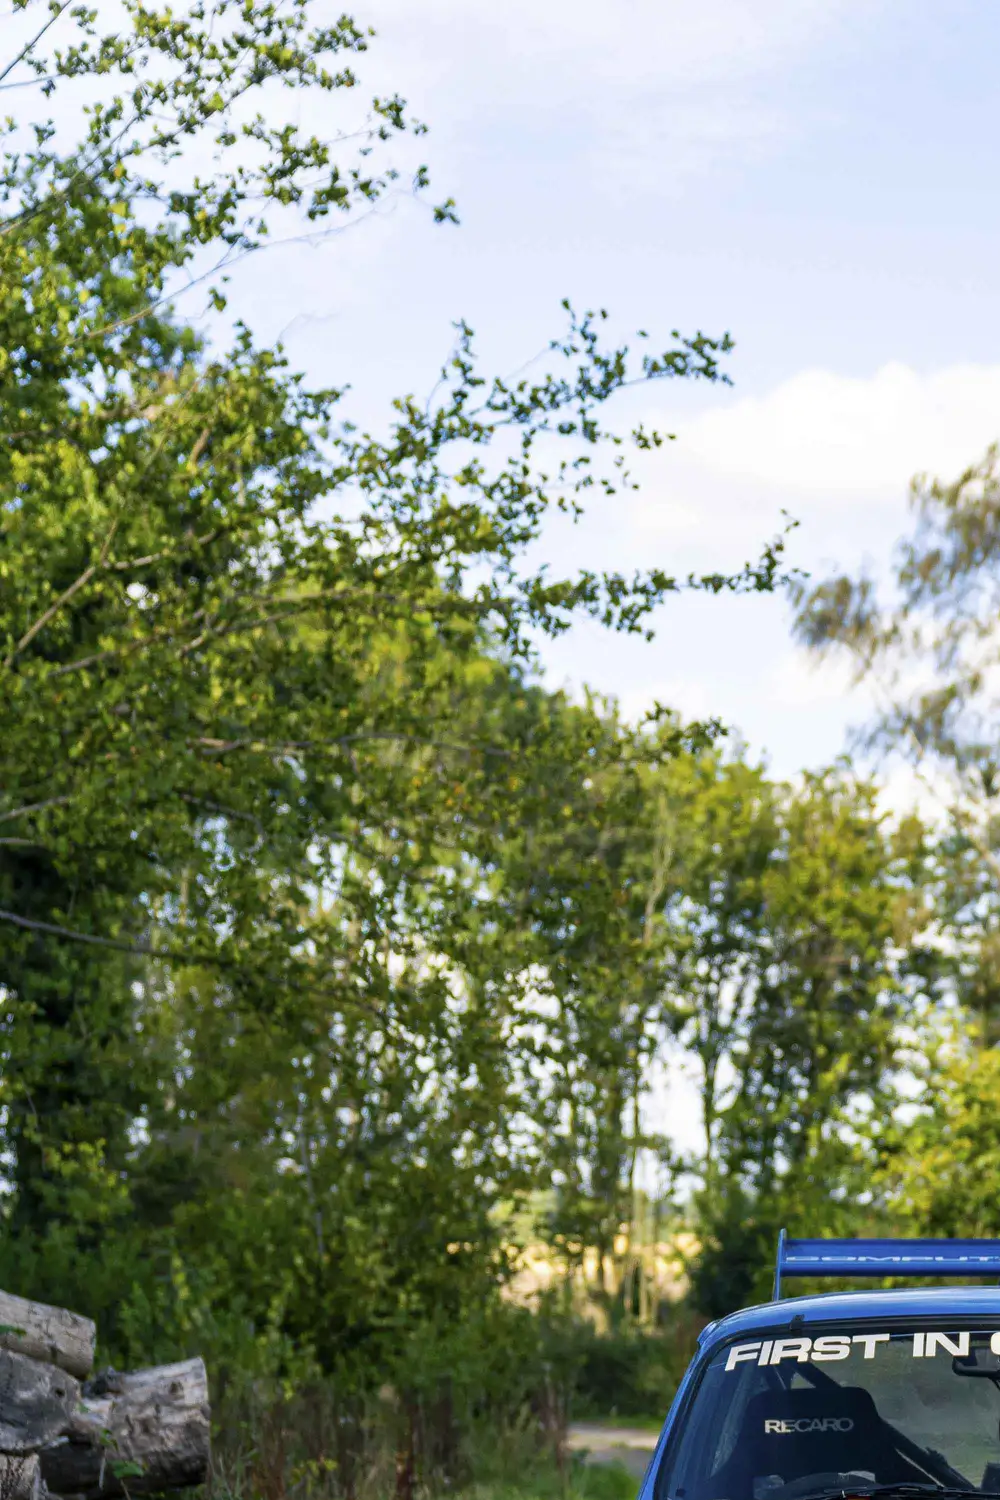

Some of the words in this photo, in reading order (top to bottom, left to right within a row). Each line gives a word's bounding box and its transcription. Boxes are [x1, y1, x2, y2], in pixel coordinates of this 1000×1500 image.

[724, 1333, 890, 1372] FIRST
[912, 1332, 970, 1358] IN
[764, 1418, 854, 1434] RECARO
